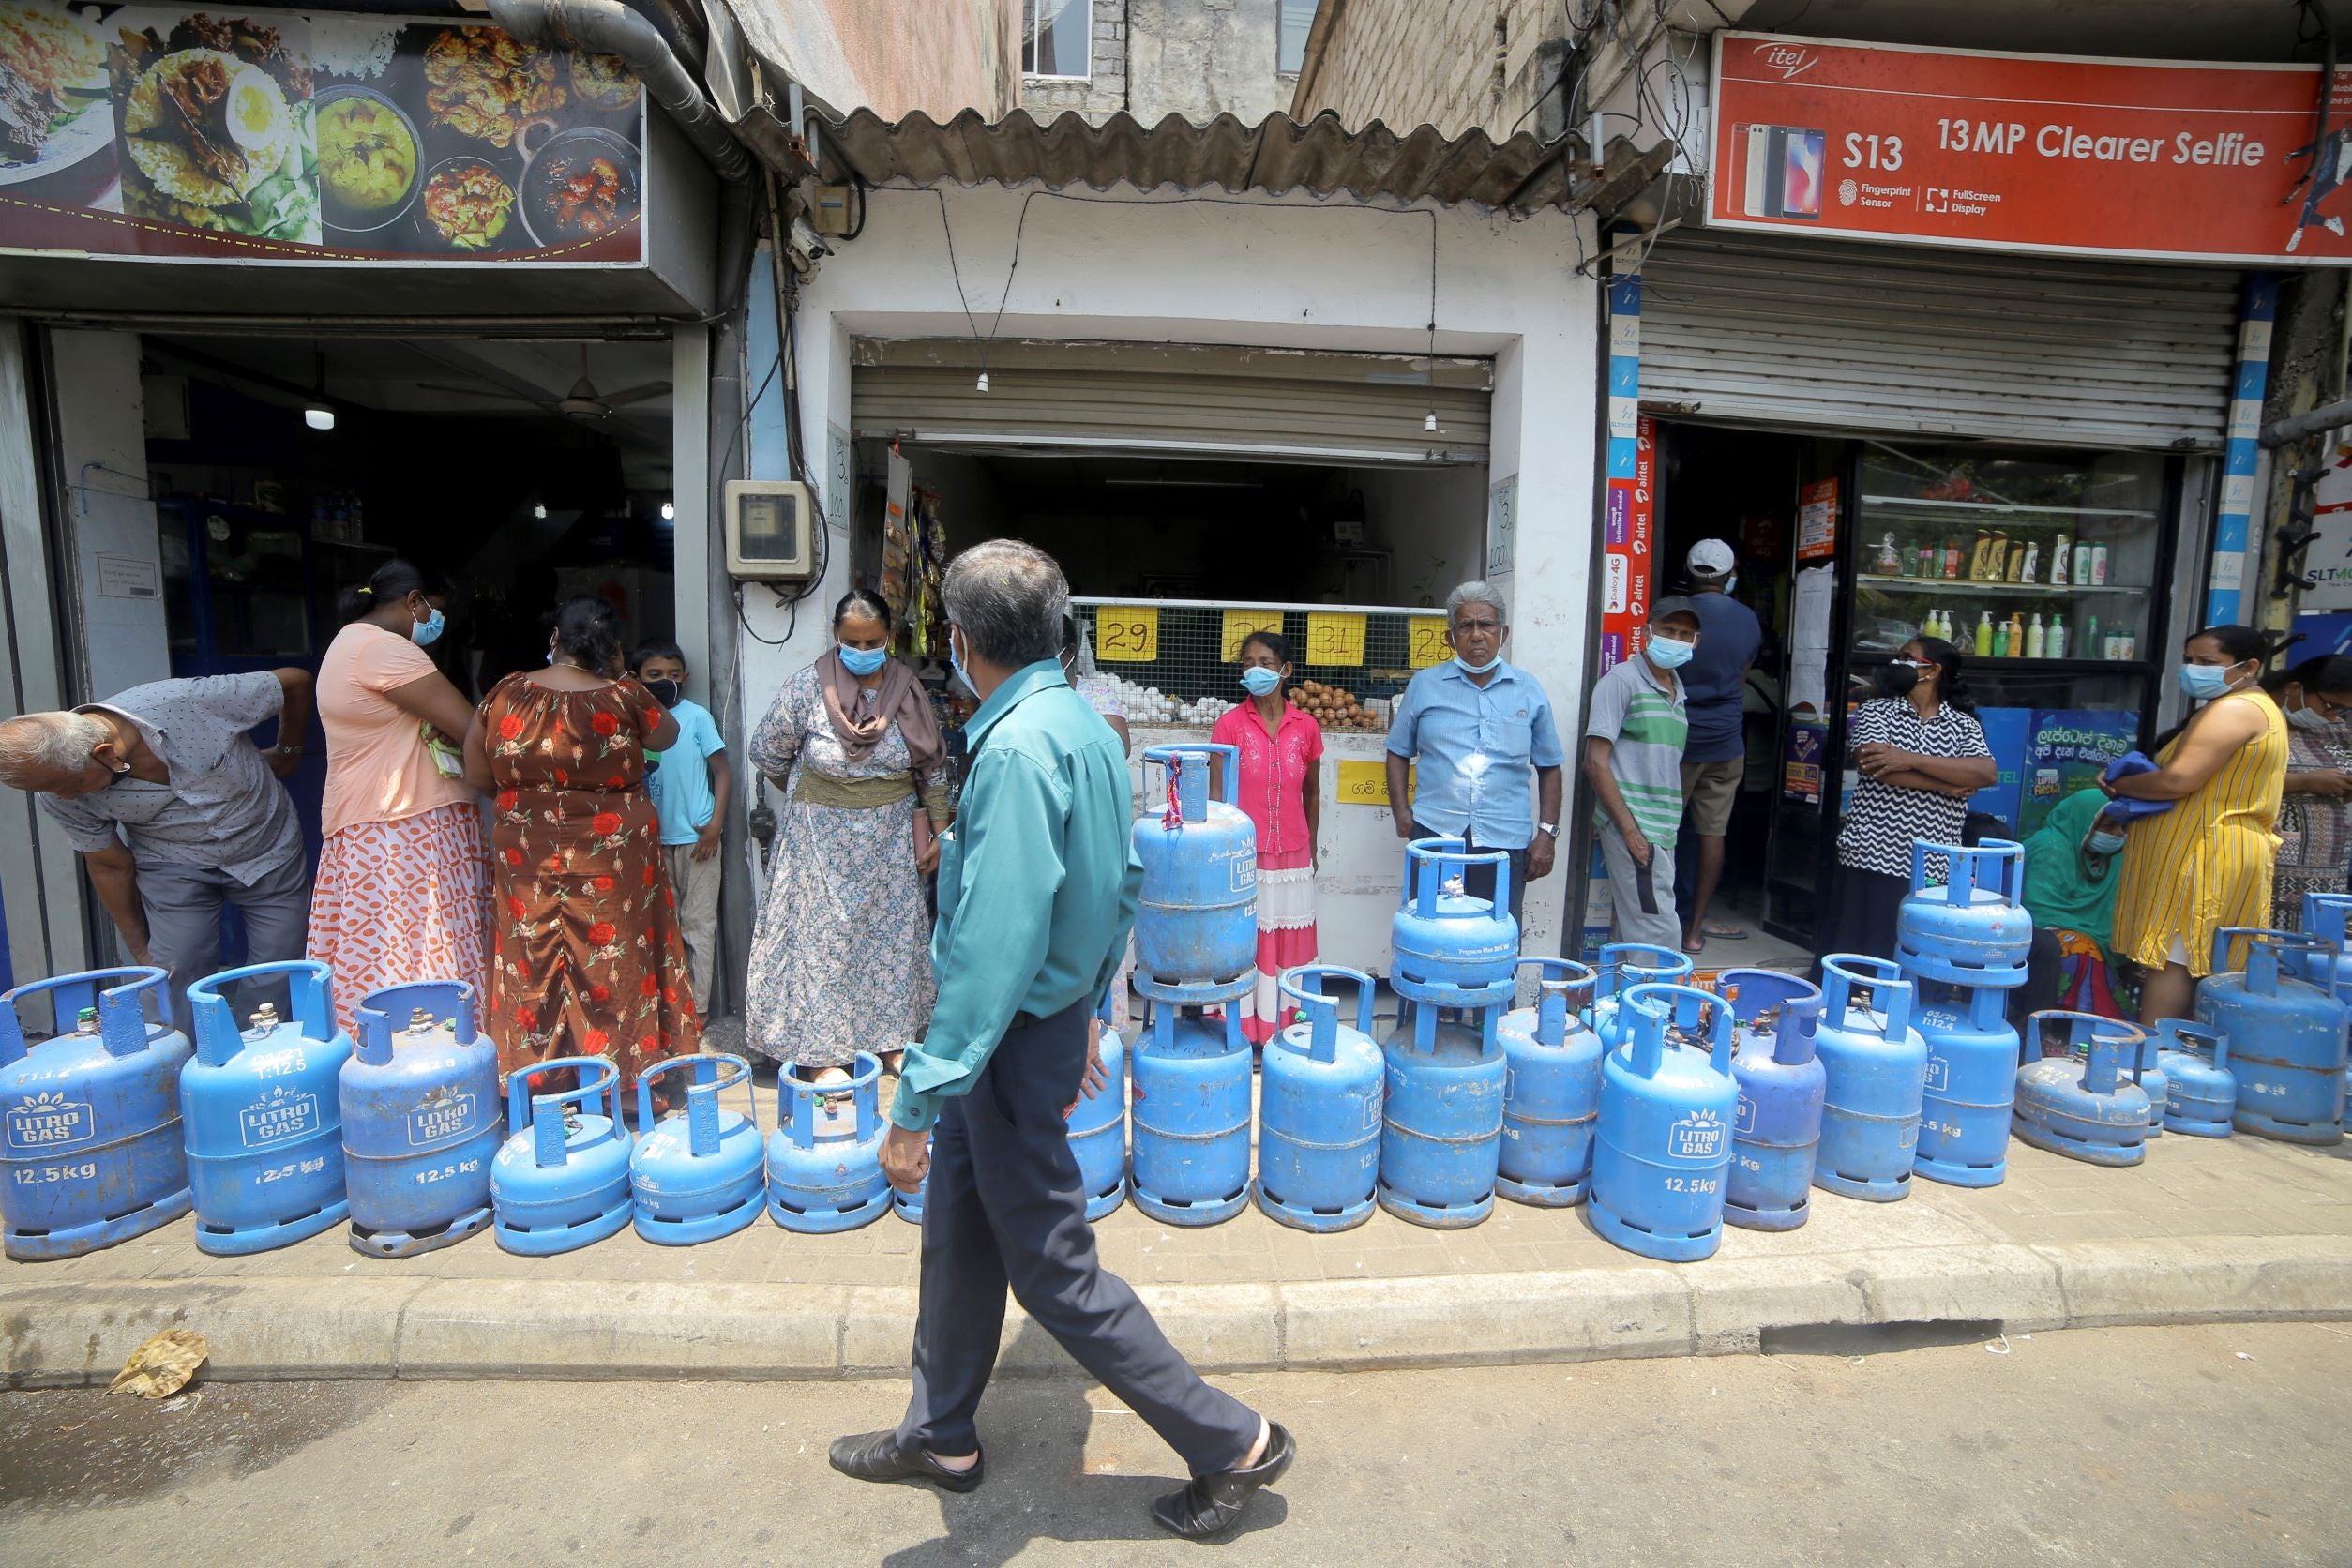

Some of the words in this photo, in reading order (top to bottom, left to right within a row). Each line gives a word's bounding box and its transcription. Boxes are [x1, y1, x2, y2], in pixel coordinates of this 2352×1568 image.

[1768, 47, 1806, 65] itel
[1843, 132, 1903, 172] S13
[1937, 118, 2026, 154] 13MP
[2036, 124, 2164, 162] Clearer
[2172, 131, 2265, 167] Selfie
[1861, 183, 1912, 197] Fingerprint
[1952, 189, 2001, 203] FullScreen
[1861, 196, 1892, 208] Sensor
[1952, 203, 1987, 217] Display
[1639, 460, 1648, 487] airtel
[1636, 513, 1646, 539] airtel
[1611, 558, 1620, 573] 4G
[1610, 576, 1619, 600] Dialog
[1634, 575, 1644, 600] airtel
[1631, 626, 1641, 652] airtel
[1926, 1009, 1957, 1022] 05/20
[15, 1112, 80, 1131] LITRO
[249, 1102, 310, 1127] LITRO
[417, 1103, 468, 1127] LITRO
[23, 1126, 70, 1142] GAS
[259, 1117, 305, 1138] GAS
[425, 1117, 463, 1138] GAS
[1679, 1129, 1720, 1142] LITRO
[1681, 1142, 1713, 1154] GAS
[415, 1166, 456, 1184] 12.5
[460, 1159, 479, 1174] kg
